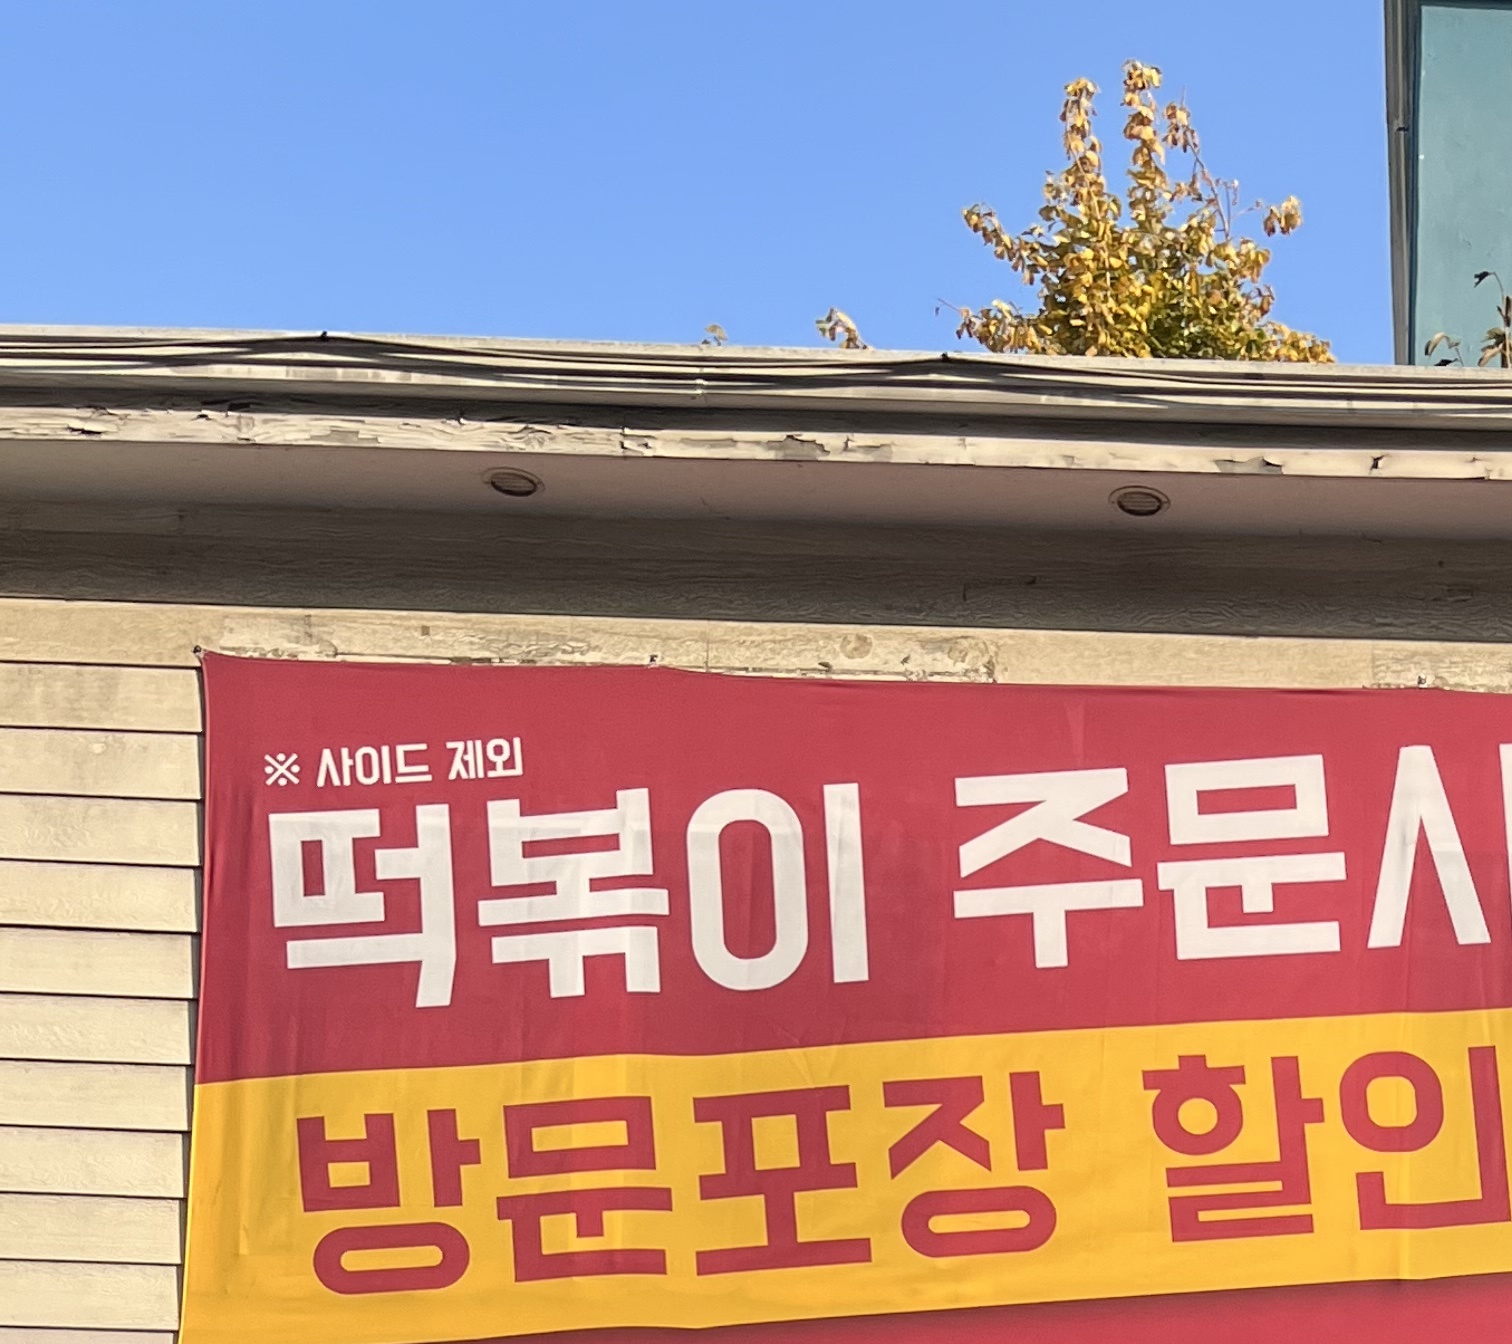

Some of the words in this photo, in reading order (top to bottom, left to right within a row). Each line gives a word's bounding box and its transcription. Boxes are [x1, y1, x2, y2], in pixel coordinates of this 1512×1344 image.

[317, 743, 432, 787] 사이드
[446, 738, 523, 780] 제외
[268, 783, 870, 1008] 떡볶이
[296, 1071, 1065, 1295] 방문포장
[1143, 1046, 1511, 1243] 할인
